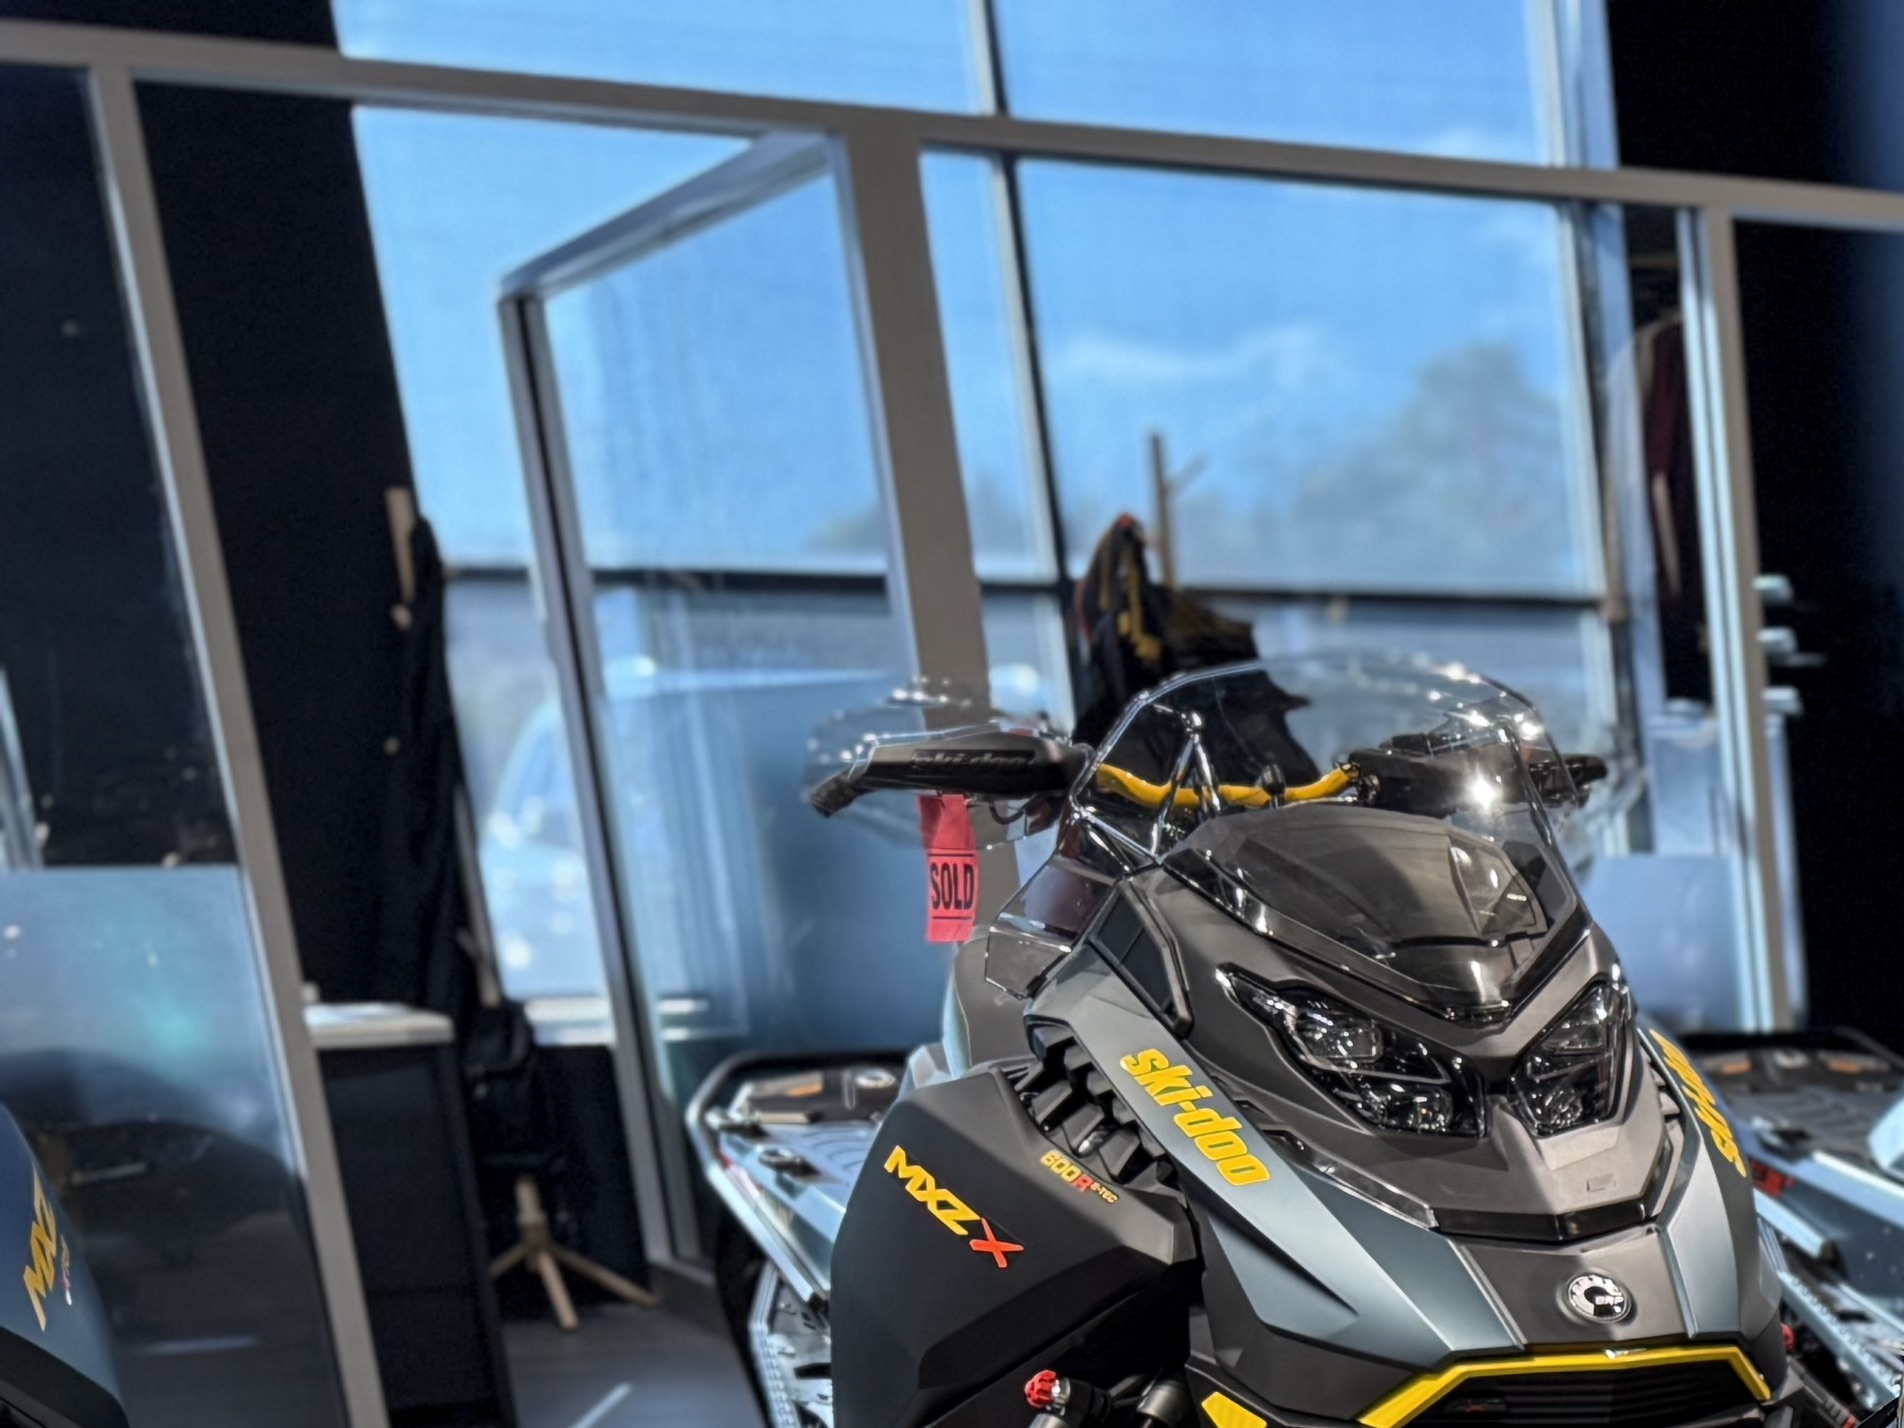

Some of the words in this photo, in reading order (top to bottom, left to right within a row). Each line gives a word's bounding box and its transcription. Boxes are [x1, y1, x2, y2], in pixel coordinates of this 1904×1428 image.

[929, 862, 975, 911] SOLD
[1120, 1048, 1271, 1186] ski-doo
[884, 1144, 982, 1236] MXZ
[968, 1217, 1025, 1269] X
